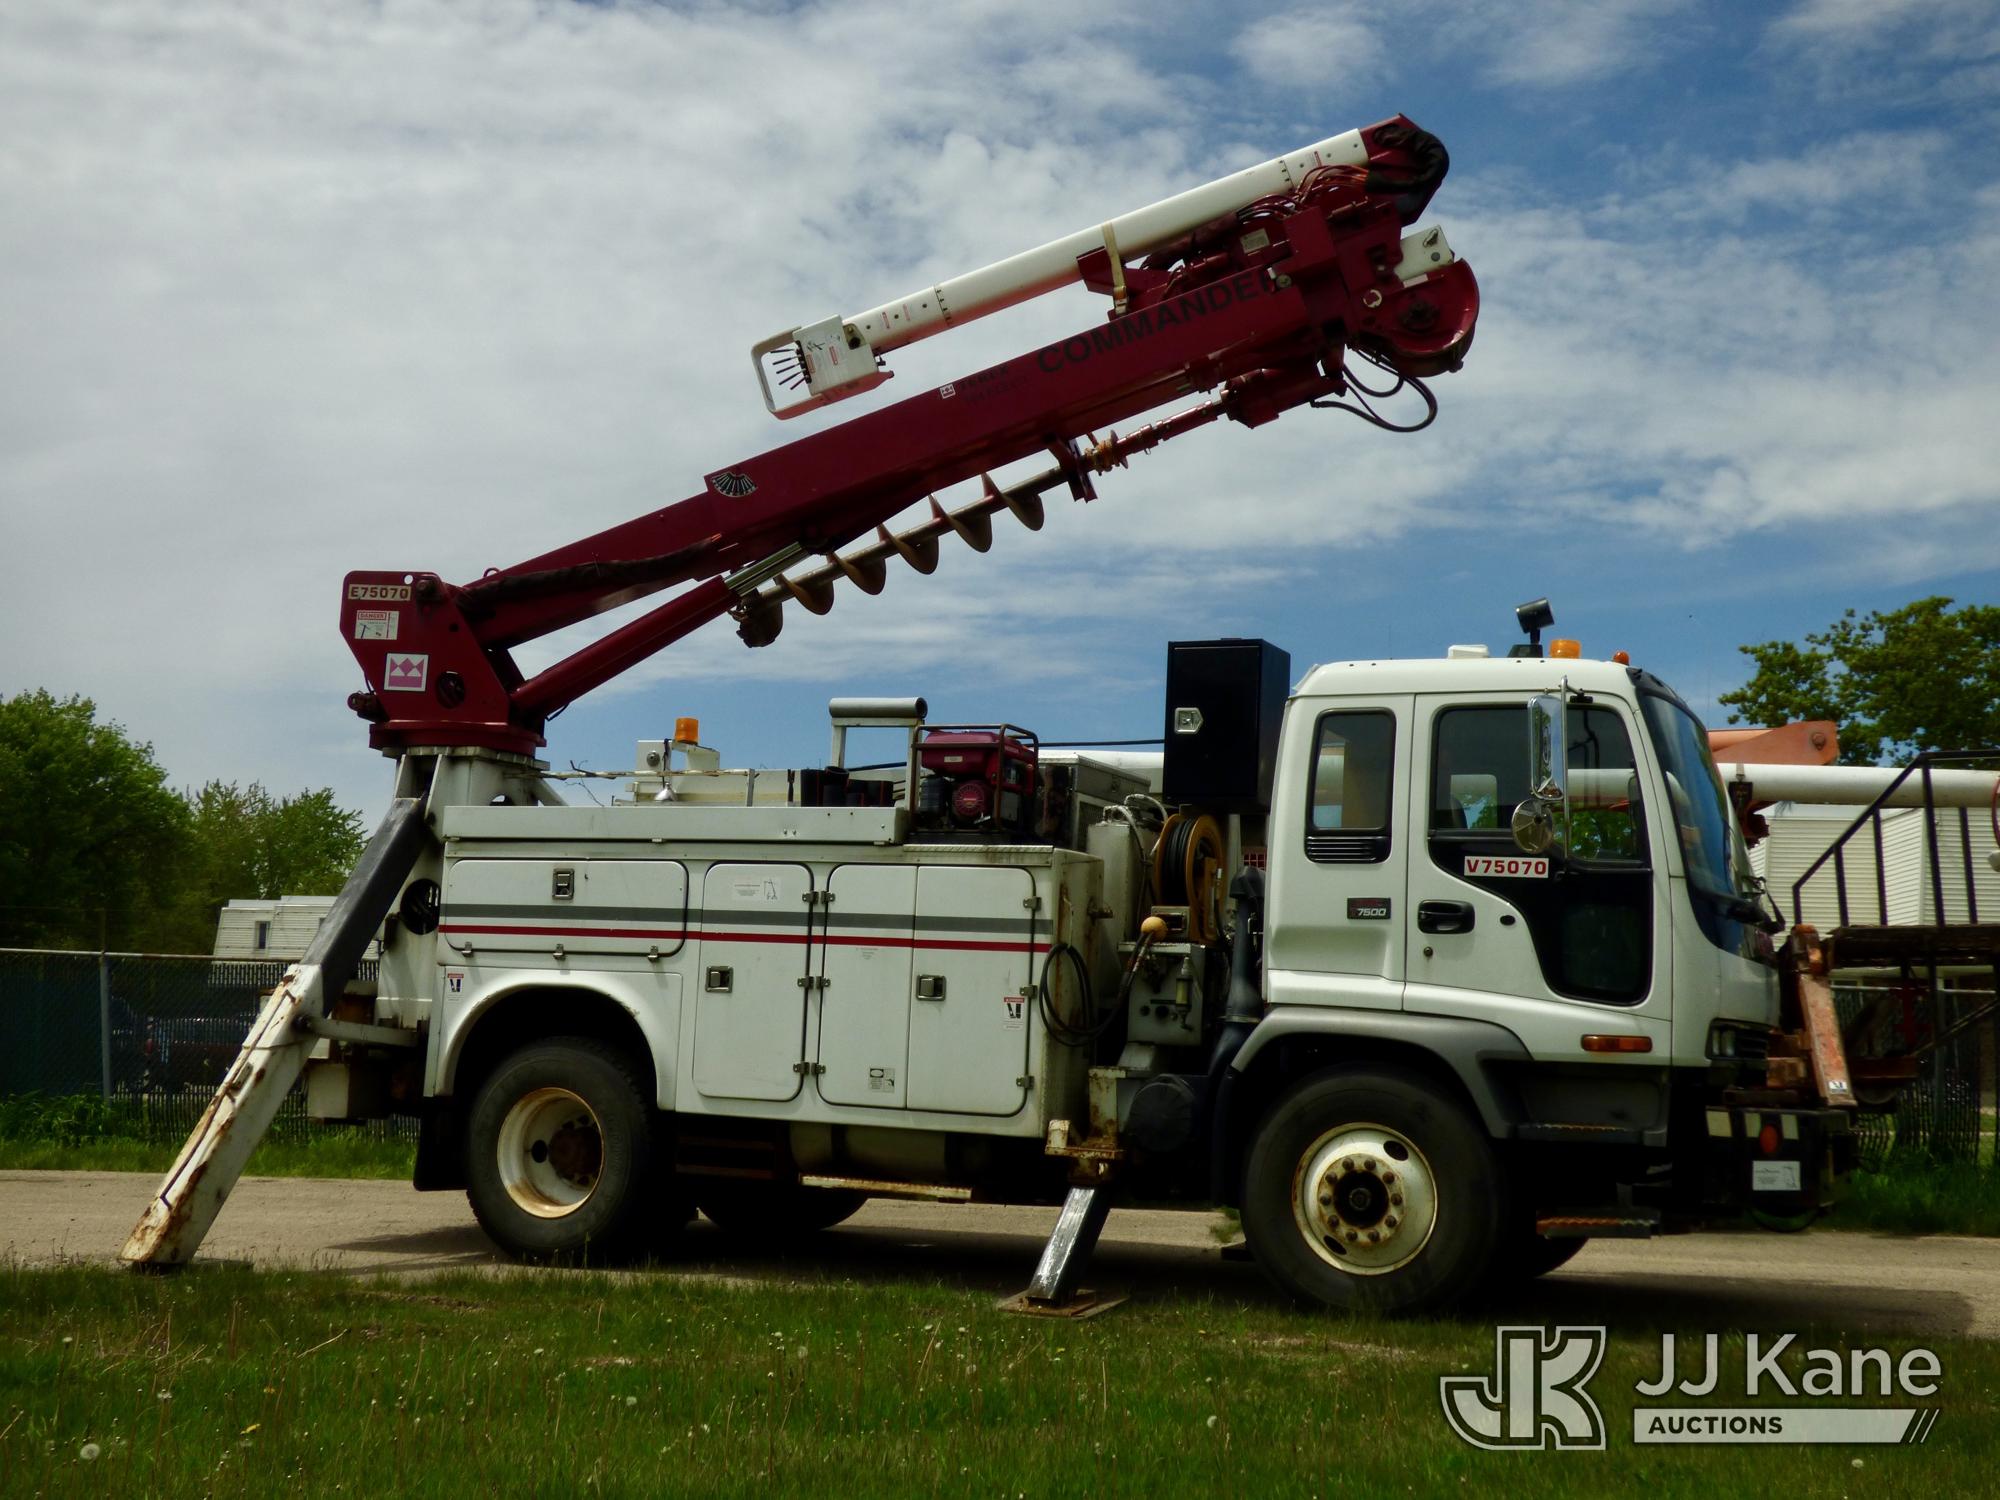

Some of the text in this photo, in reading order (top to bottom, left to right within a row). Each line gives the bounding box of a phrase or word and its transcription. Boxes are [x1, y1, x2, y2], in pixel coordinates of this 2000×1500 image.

[351, 586, 409, 600] E75070
[1466, 859, 1548, 876] V75070
[1356, 907, 1387, 917] 7500
